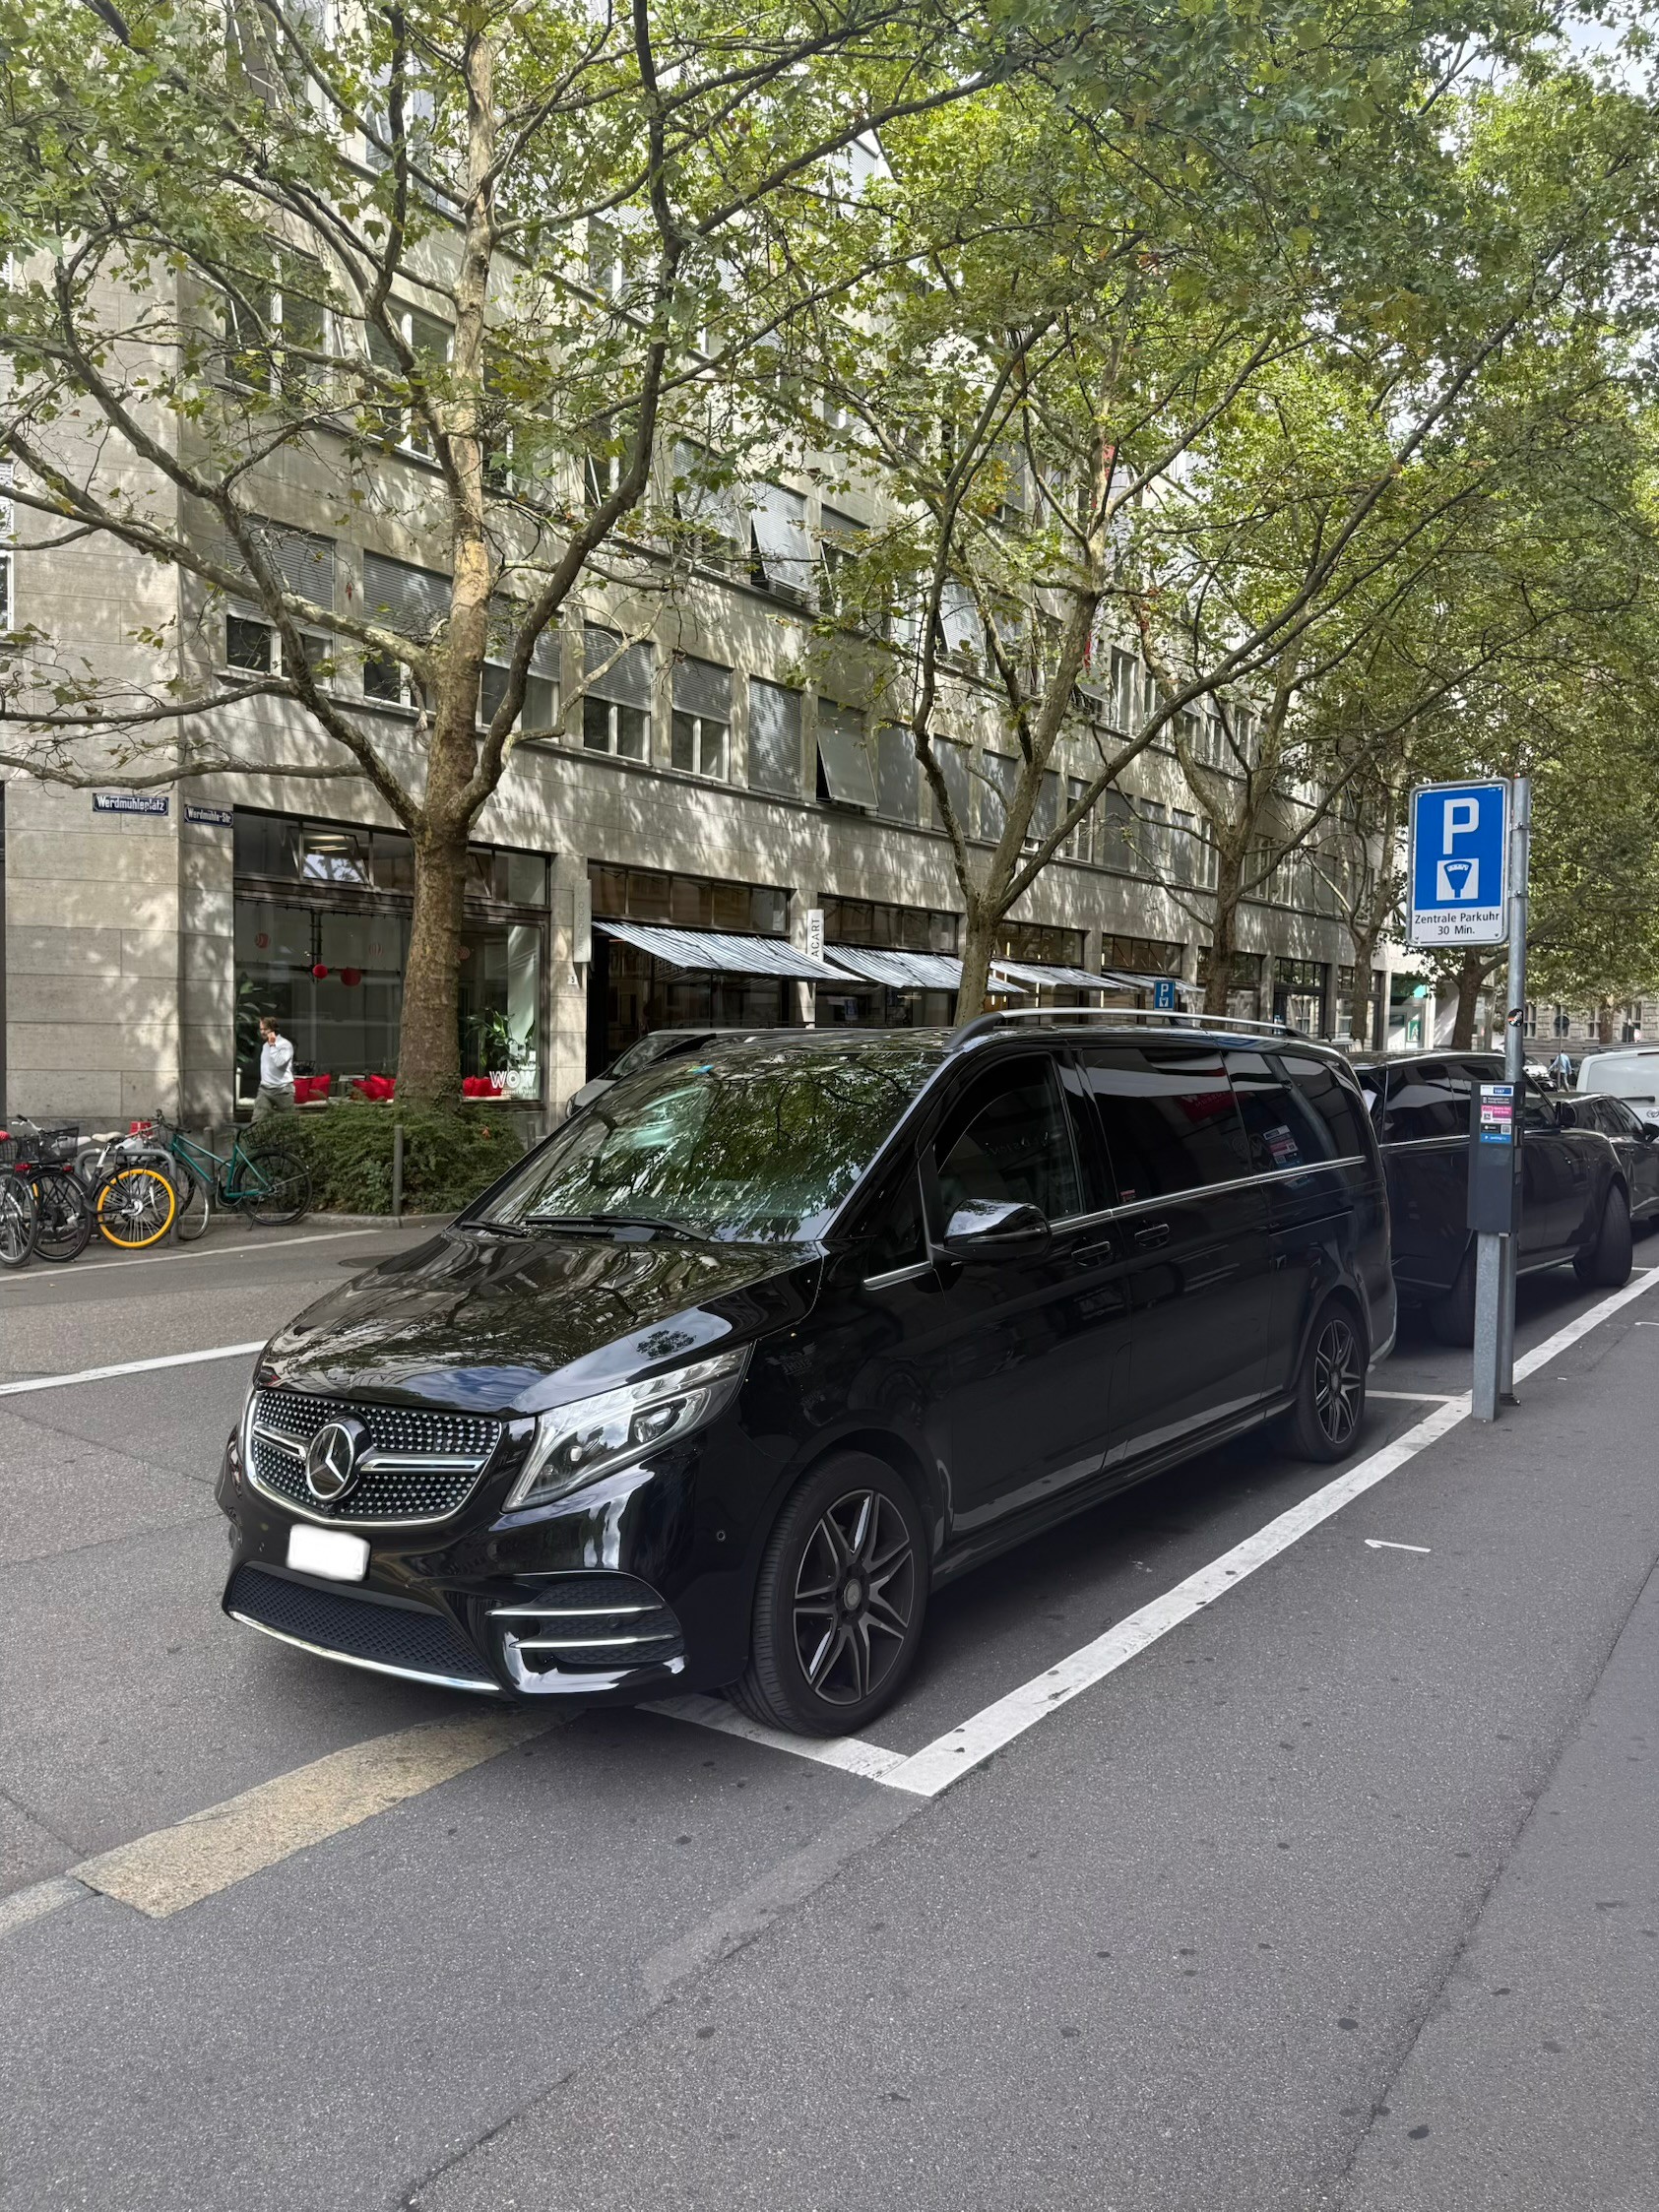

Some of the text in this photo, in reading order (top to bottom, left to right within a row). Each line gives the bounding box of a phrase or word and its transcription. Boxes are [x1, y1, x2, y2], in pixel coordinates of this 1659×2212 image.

[96, 794, 165, 812] Werdmühleplatz
[1442, 797, 1480, 855] P
[1414, 912, 1500, 924] Zentrale Parkuhr
[1437, 924, 1476, 935] 30 Min.
[811, 918, 820, 961] ACART
[1161, 982, 1169, 997] P
[488, 1070, 537, 1089] WOW
